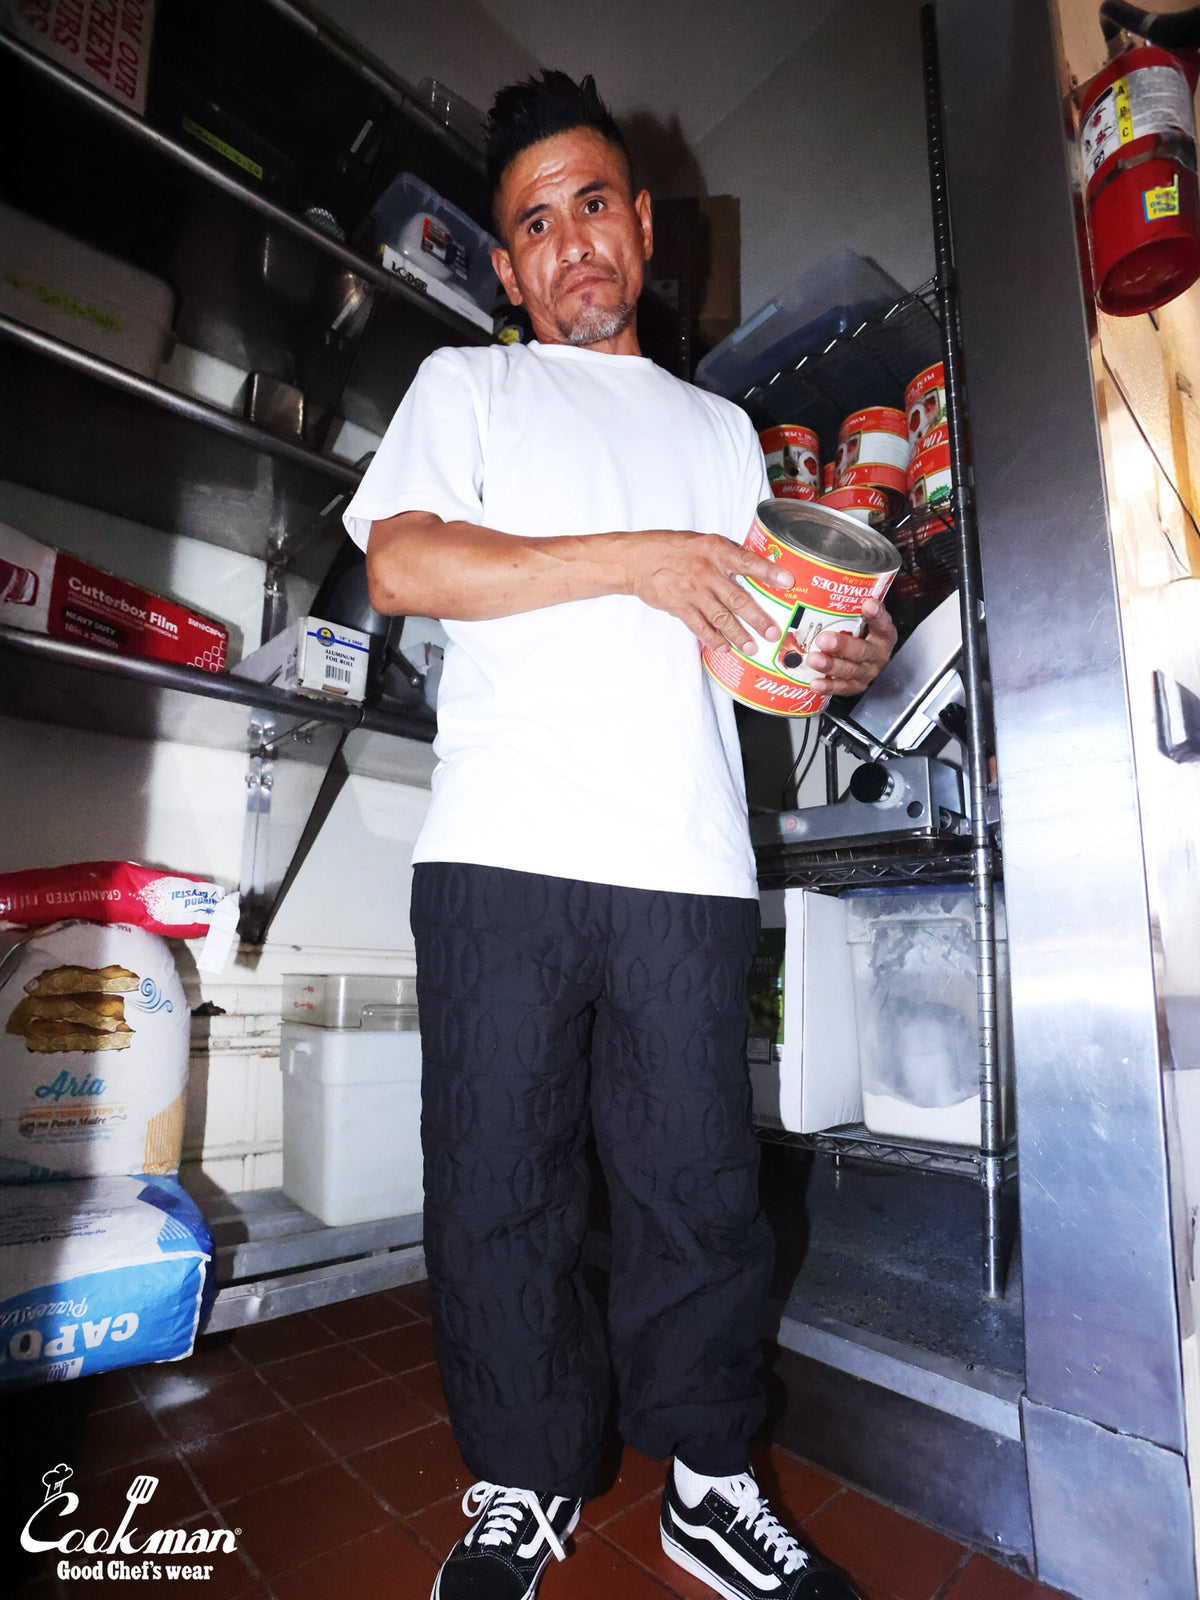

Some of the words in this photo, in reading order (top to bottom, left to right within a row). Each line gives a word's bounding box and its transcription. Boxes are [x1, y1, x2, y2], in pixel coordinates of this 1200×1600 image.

[121, 0, 147, 45] OM
[115, 41, 139, 99] OUR
[811, 575, 877, 598] TOMATOES
[830, 593, 859, 605] PEELED
[68, 576, 147, 621] Cutterbox
[150, 611, 179, 634] Film
[65, 609, 92, 626] HEAVY
[94, 620, 116, 636] DUTY
[325, 655, 339, 664] FOIL
[340, 659, 354, 667] ROLL
[753, 676, 816, 713] Cucina
[46, 889, 121, 905] GRANULATED
[35, 1069, 107, 1101] Aria
